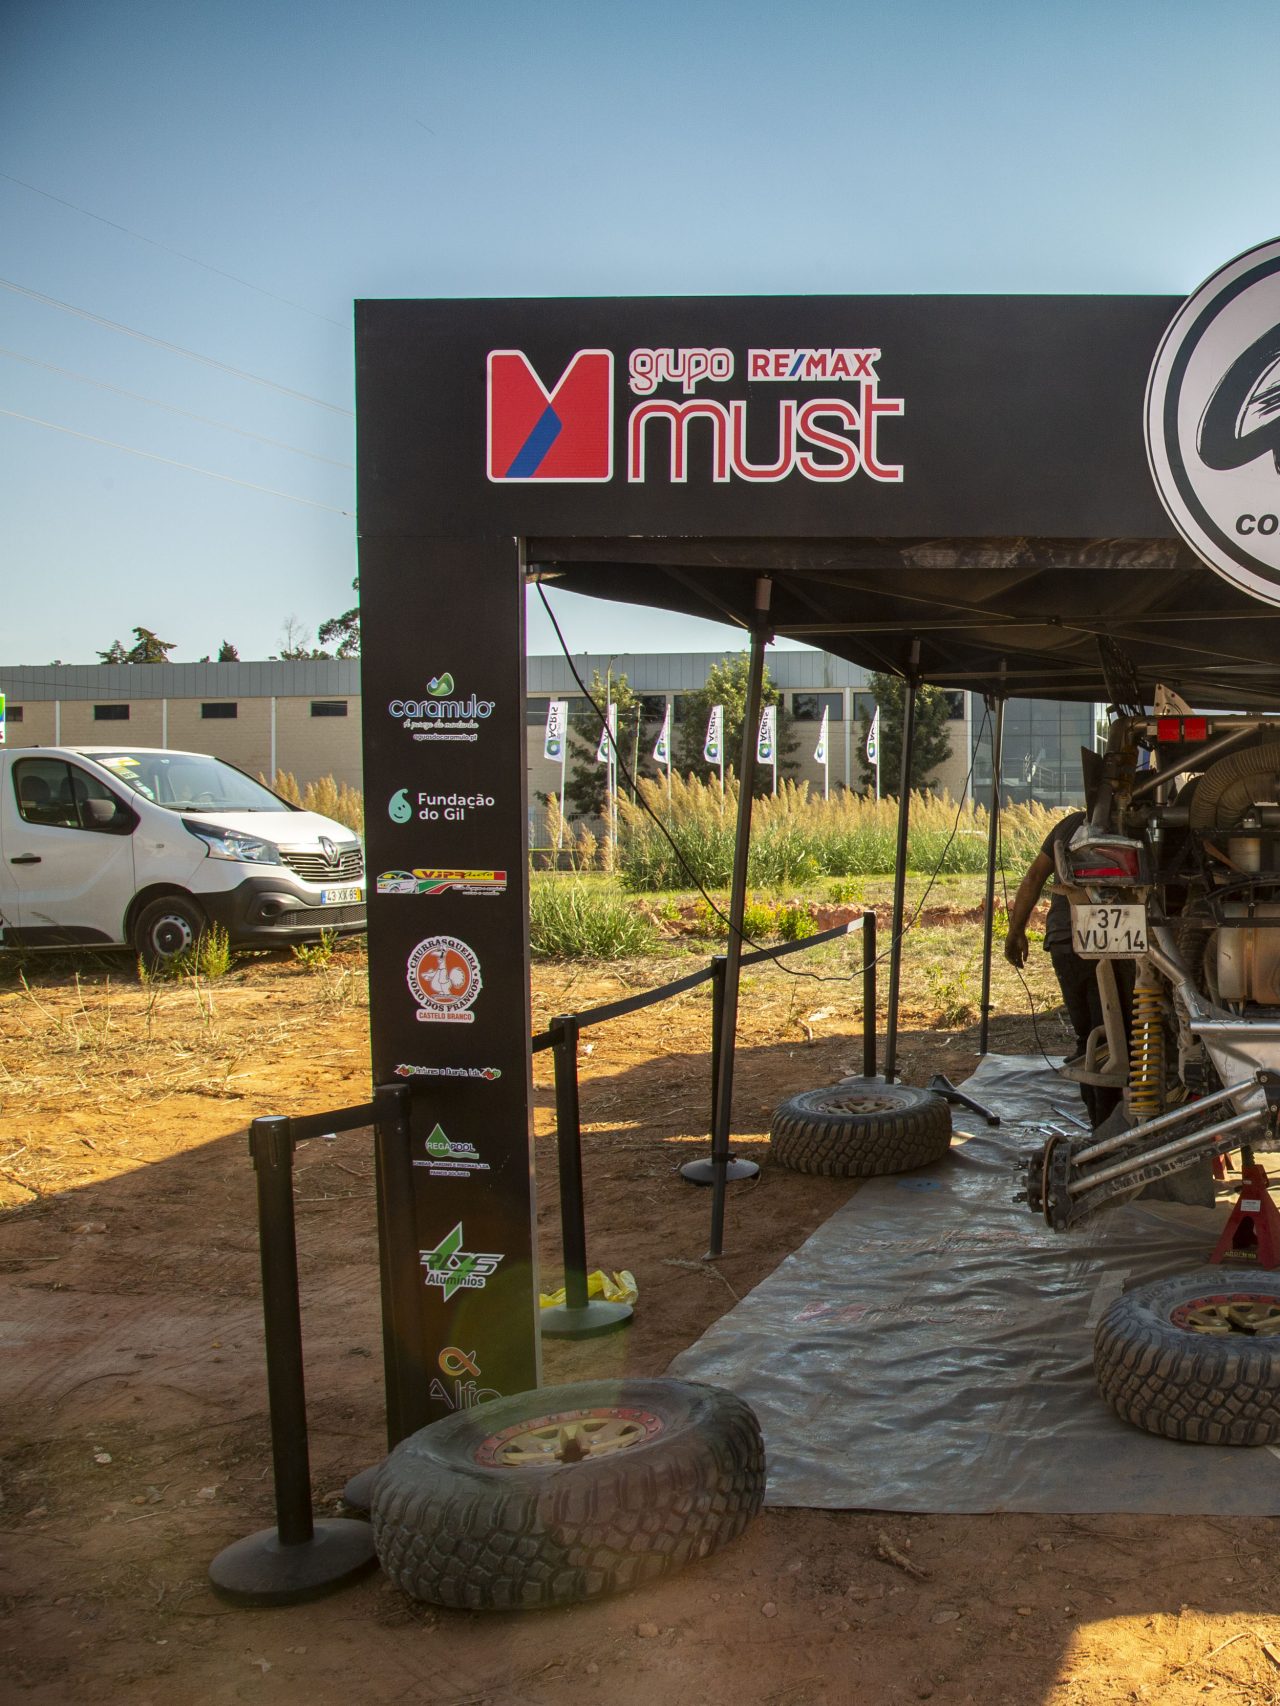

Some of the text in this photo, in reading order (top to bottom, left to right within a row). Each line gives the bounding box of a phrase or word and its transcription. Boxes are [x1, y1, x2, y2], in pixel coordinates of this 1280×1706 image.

[628, 347, 880, 395] grupo RE/MAX
[627, 383, 905, 484] must
[388, 694, 495, 719] caramulo
[418, 792, 495, 810] Fundação
[419, 807, 464, 820] do Gil
[1098, 909, 1121, 928] 37
[410, 939, 477, 970] CHURRASQUEIRA
[425, 1000, 445, 1012] DOS
[447, 978, 479, 1012] FRANGOS
[427, 1142, 475, 1152] REGAPOOL
